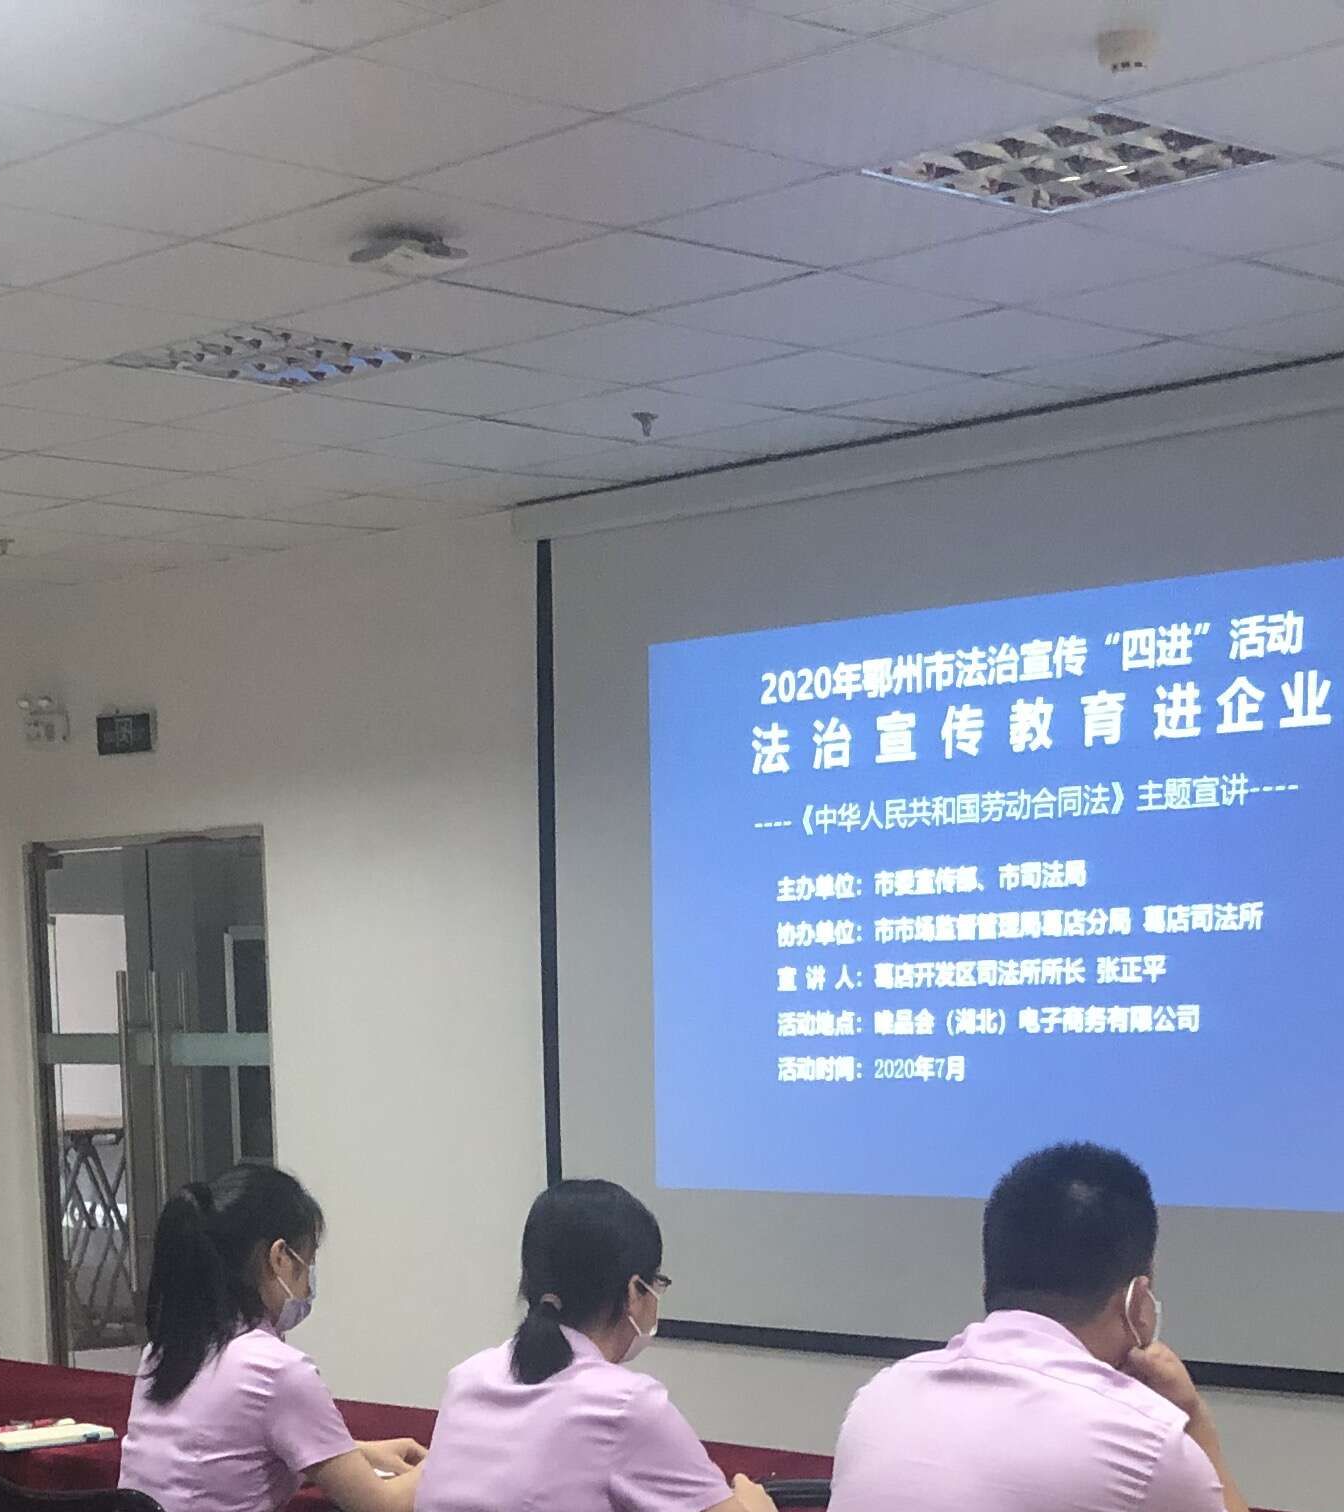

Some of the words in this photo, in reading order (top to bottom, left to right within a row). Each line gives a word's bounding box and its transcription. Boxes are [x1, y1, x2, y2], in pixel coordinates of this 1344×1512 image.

[751, 669, 1332, 775] 法治宣传教育进企业
